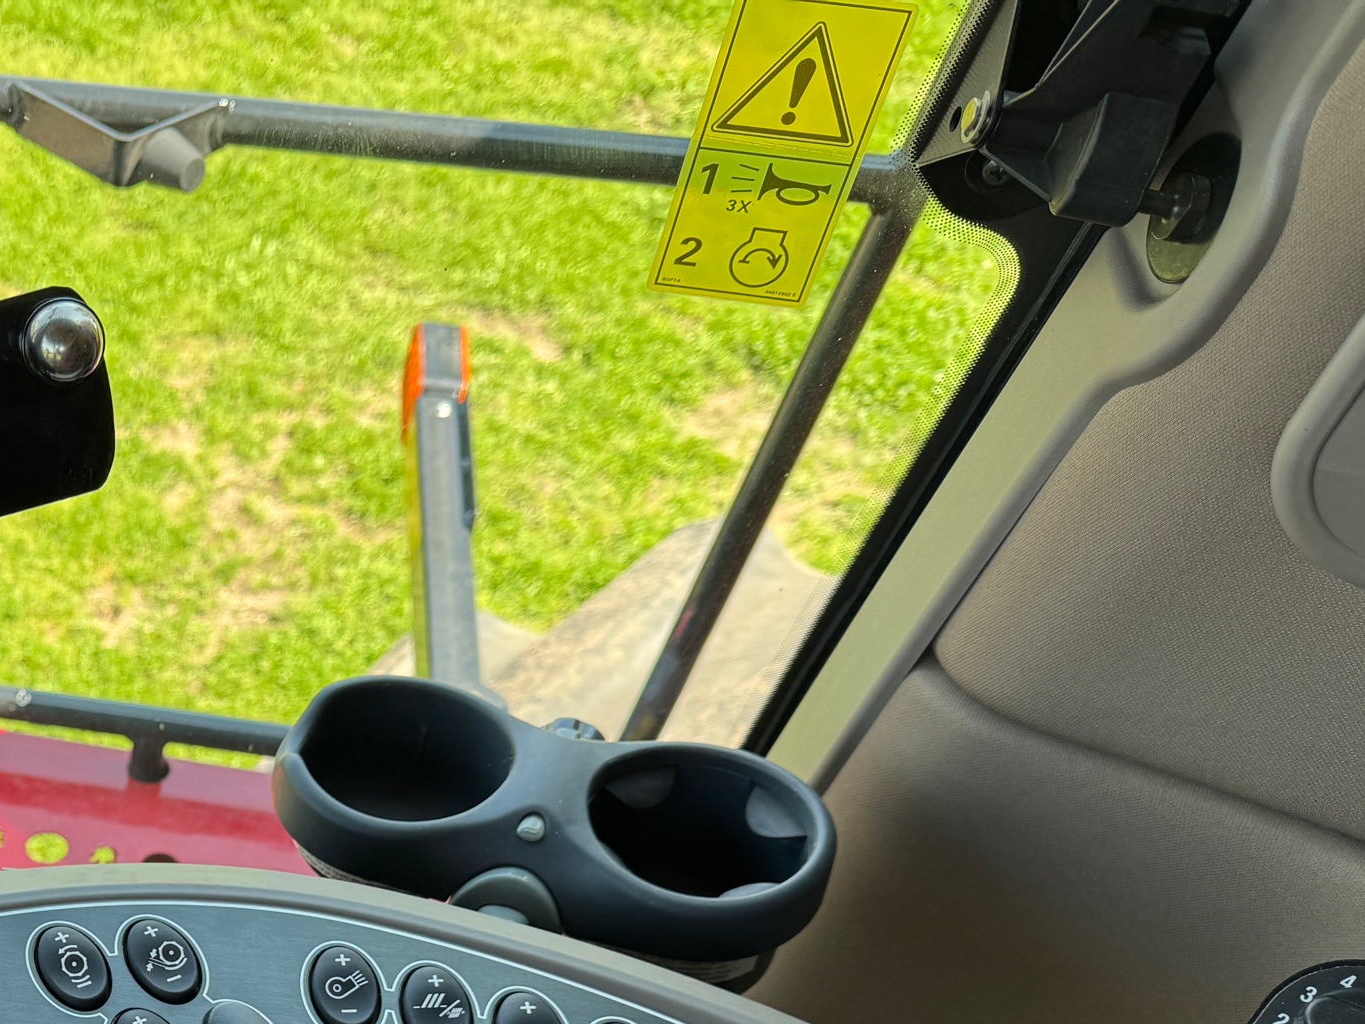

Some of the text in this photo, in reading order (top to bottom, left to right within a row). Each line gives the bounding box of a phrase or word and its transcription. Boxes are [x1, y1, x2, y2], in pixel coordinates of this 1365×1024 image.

[700, 163, 720, 195] 1
[725, 199, 752, 214] 3X
[673, 236, 703, 268] 2
[1339, 974, 1358, 989] 4
[1299, 986, 1318, 1003] 3
